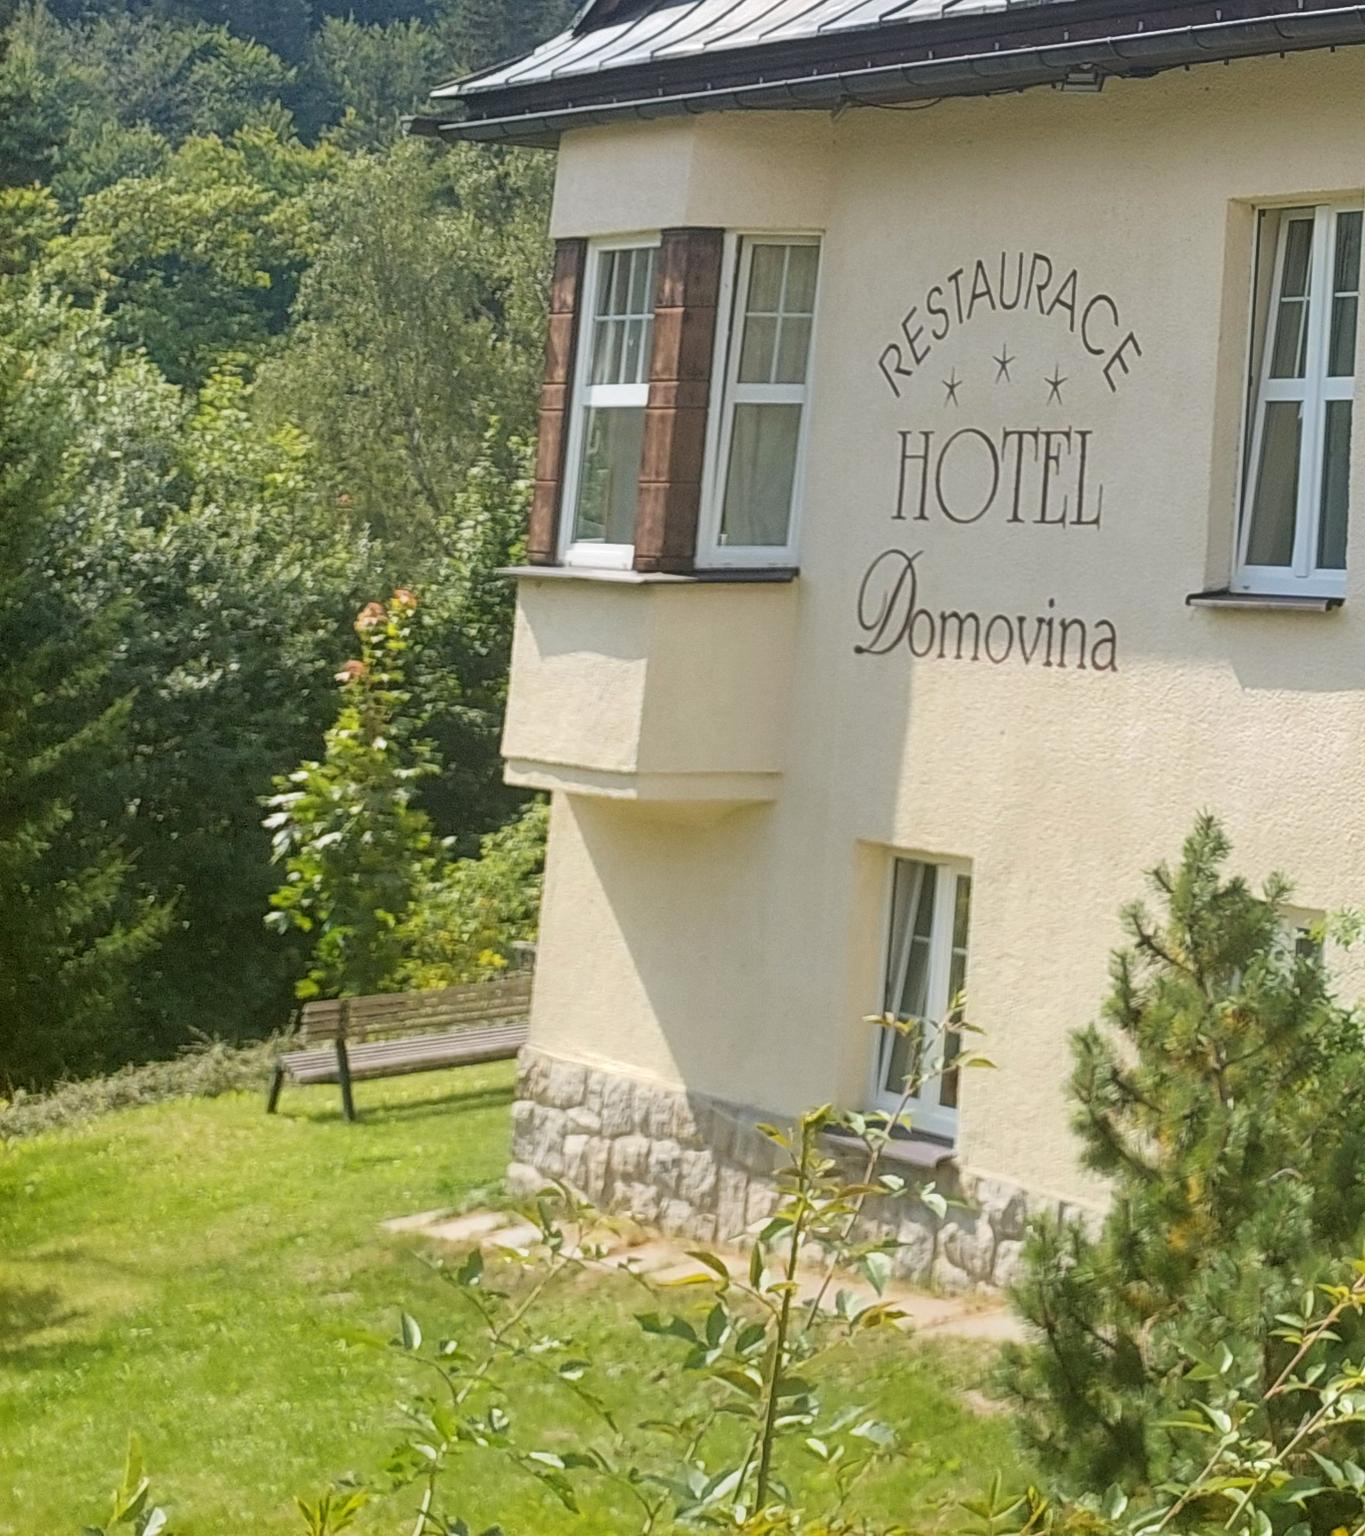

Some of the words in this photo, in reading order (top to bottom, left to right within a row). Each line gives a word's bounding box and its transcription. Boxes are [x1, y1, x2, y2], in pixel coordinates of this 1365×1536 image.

[878, 251, 1142, 398] RESTAURACE
[891, 425, 1103, 530] HOTEL
[854, 548, 1119, 672] Domovina
